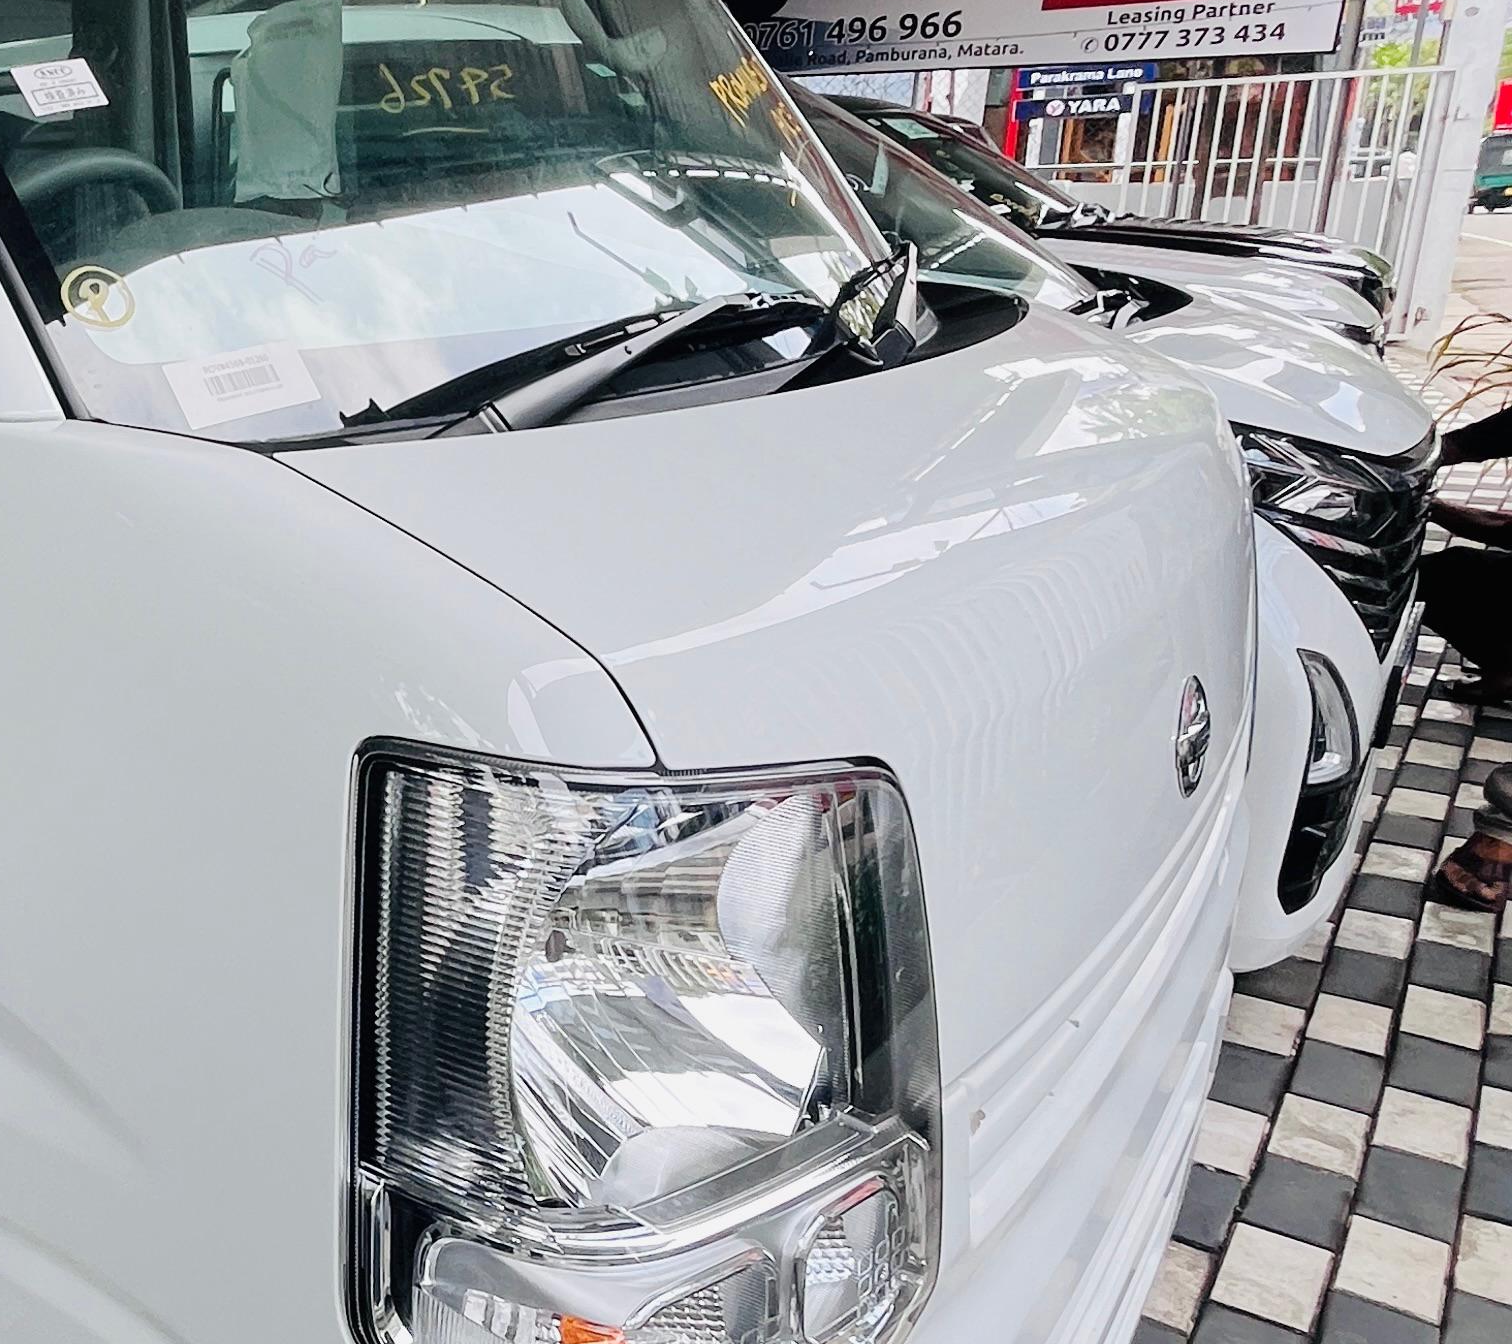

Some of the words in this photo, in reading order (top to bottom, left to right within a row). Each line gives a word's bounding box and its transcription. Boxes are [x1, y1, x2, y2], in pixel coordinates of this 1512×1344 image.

[1107, 6, 1185, 25] Leasing
[1192, 2, 1276, 21] Partner
[824, 15, 888, 46] 496
[898, 10, 963, 41] 966
[1104, 30, 1170, 52] 0777
[1176, 26, 1226, 47] 373
[1233, 22, 1286, 43] 434
[855, 46, 952, 64] Pamburana,
[957, 42, 1025, 58] Matara.
[1068, 97, 1121, 114] YARA
